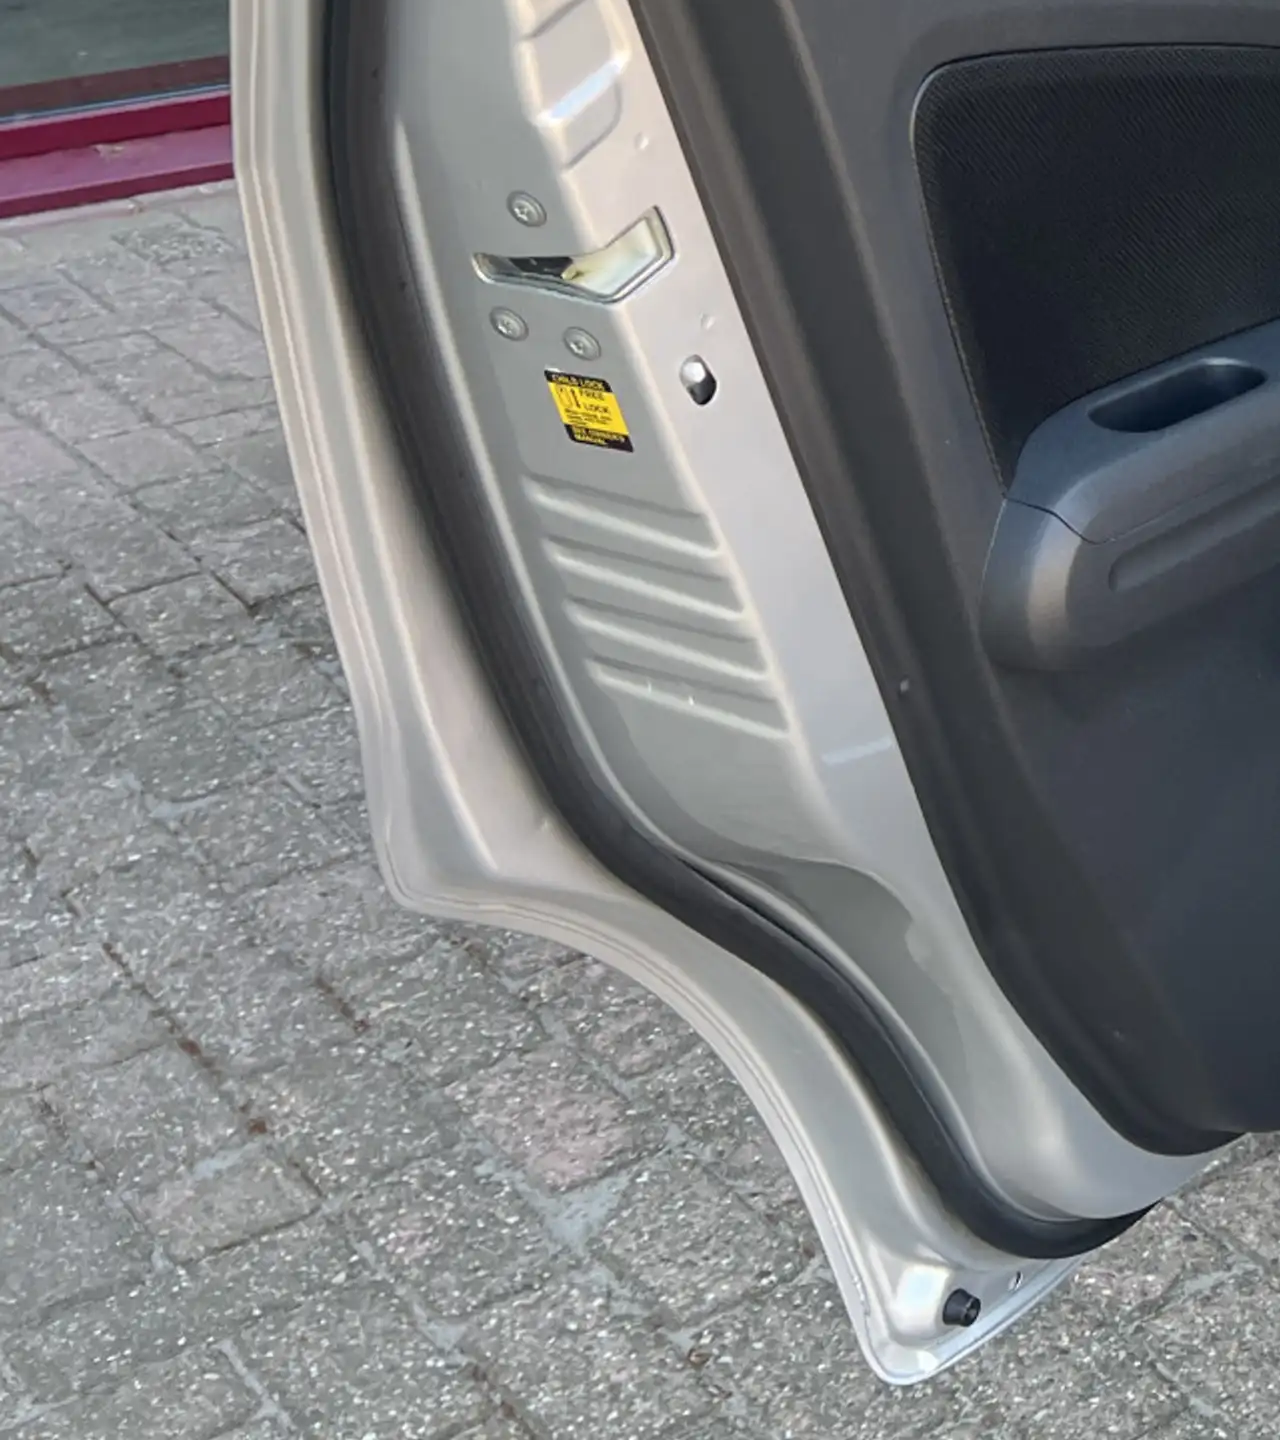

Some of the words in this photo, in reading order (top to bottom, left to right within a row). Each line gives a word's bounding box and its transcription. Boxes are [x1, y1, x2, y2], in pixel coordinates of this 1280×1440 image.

[581, 378, 605, 391] LOCK
[580, 389, 605, 401] FREE
[584, 403, 610, 415] LOCK
